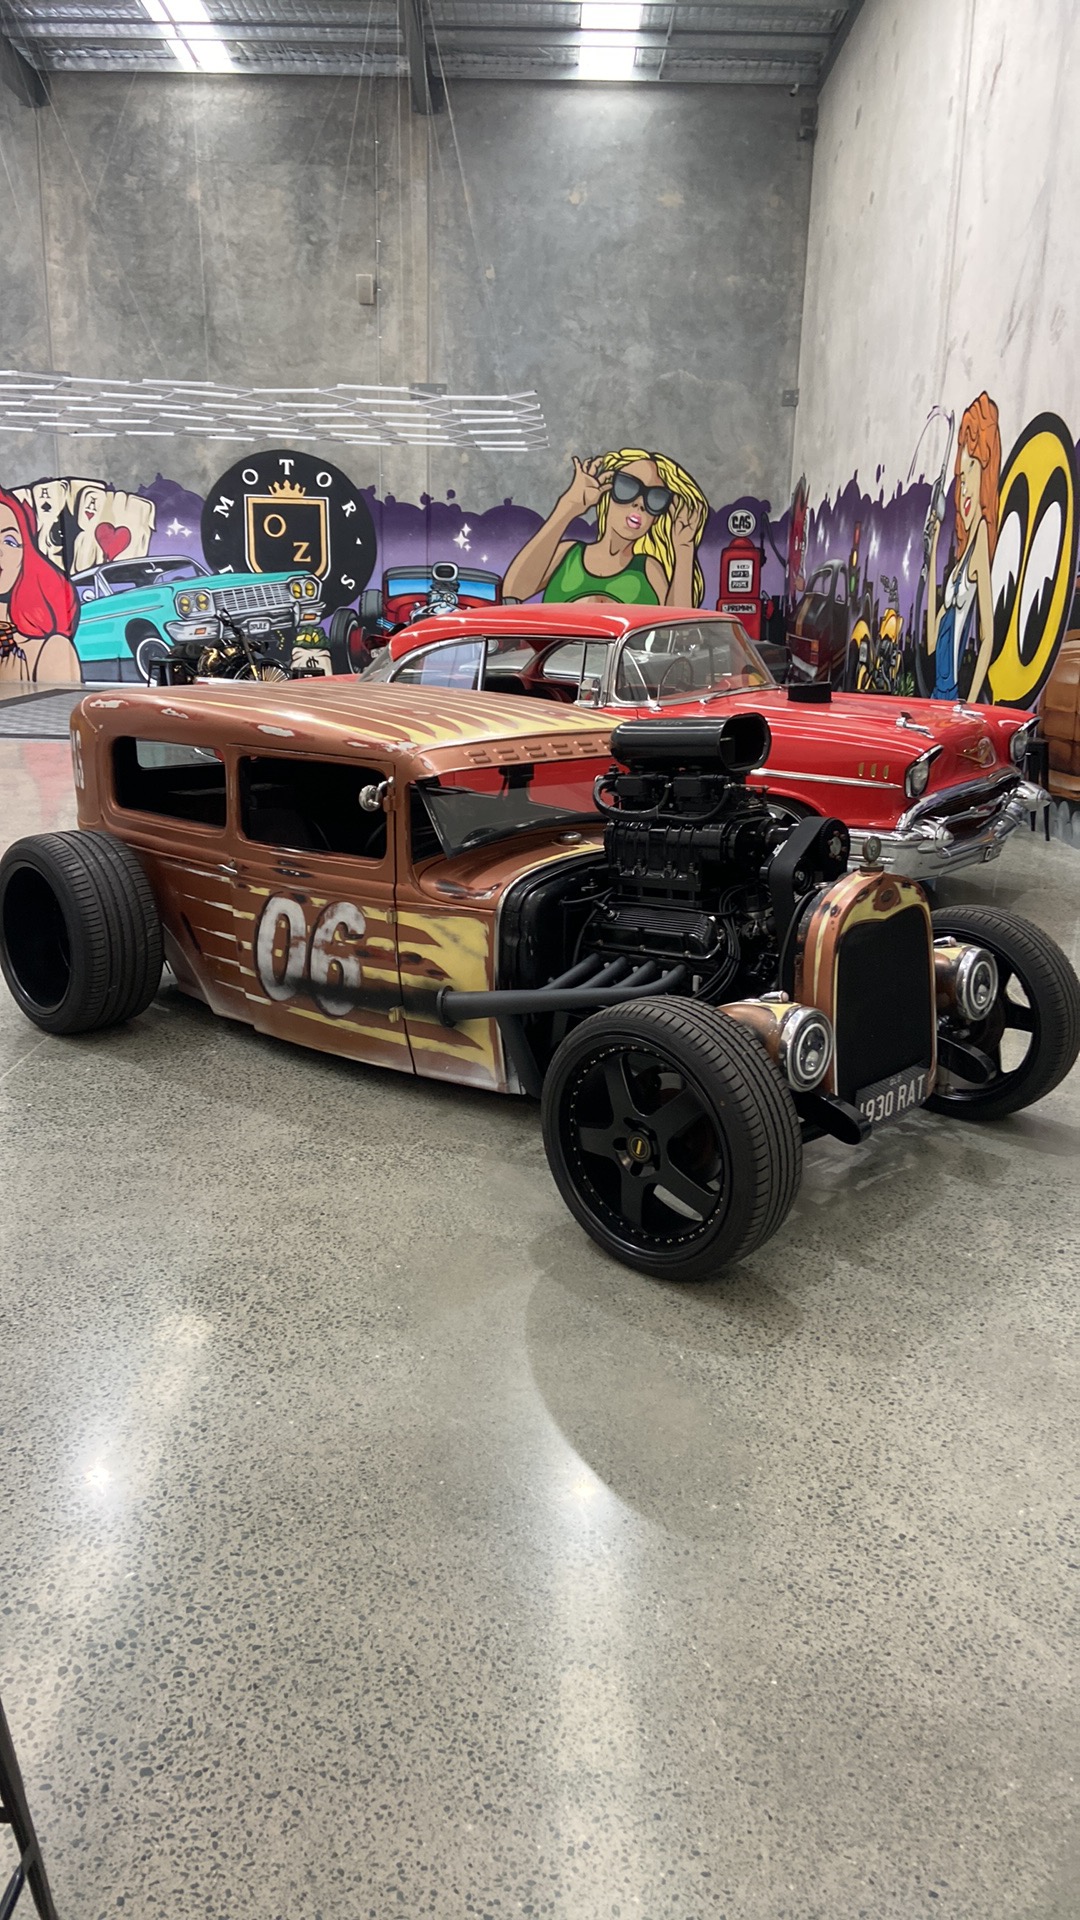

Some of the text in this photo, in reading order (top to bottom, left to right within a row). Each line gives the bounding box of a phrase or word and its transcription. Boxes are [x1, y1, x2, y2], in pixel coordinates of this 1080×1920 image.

[39, 487, 50, 499] A
[85, 496, 97, 511] A
[255, 894, 366, 1017] 06
[897, 1074, 926, 1111] RAT
